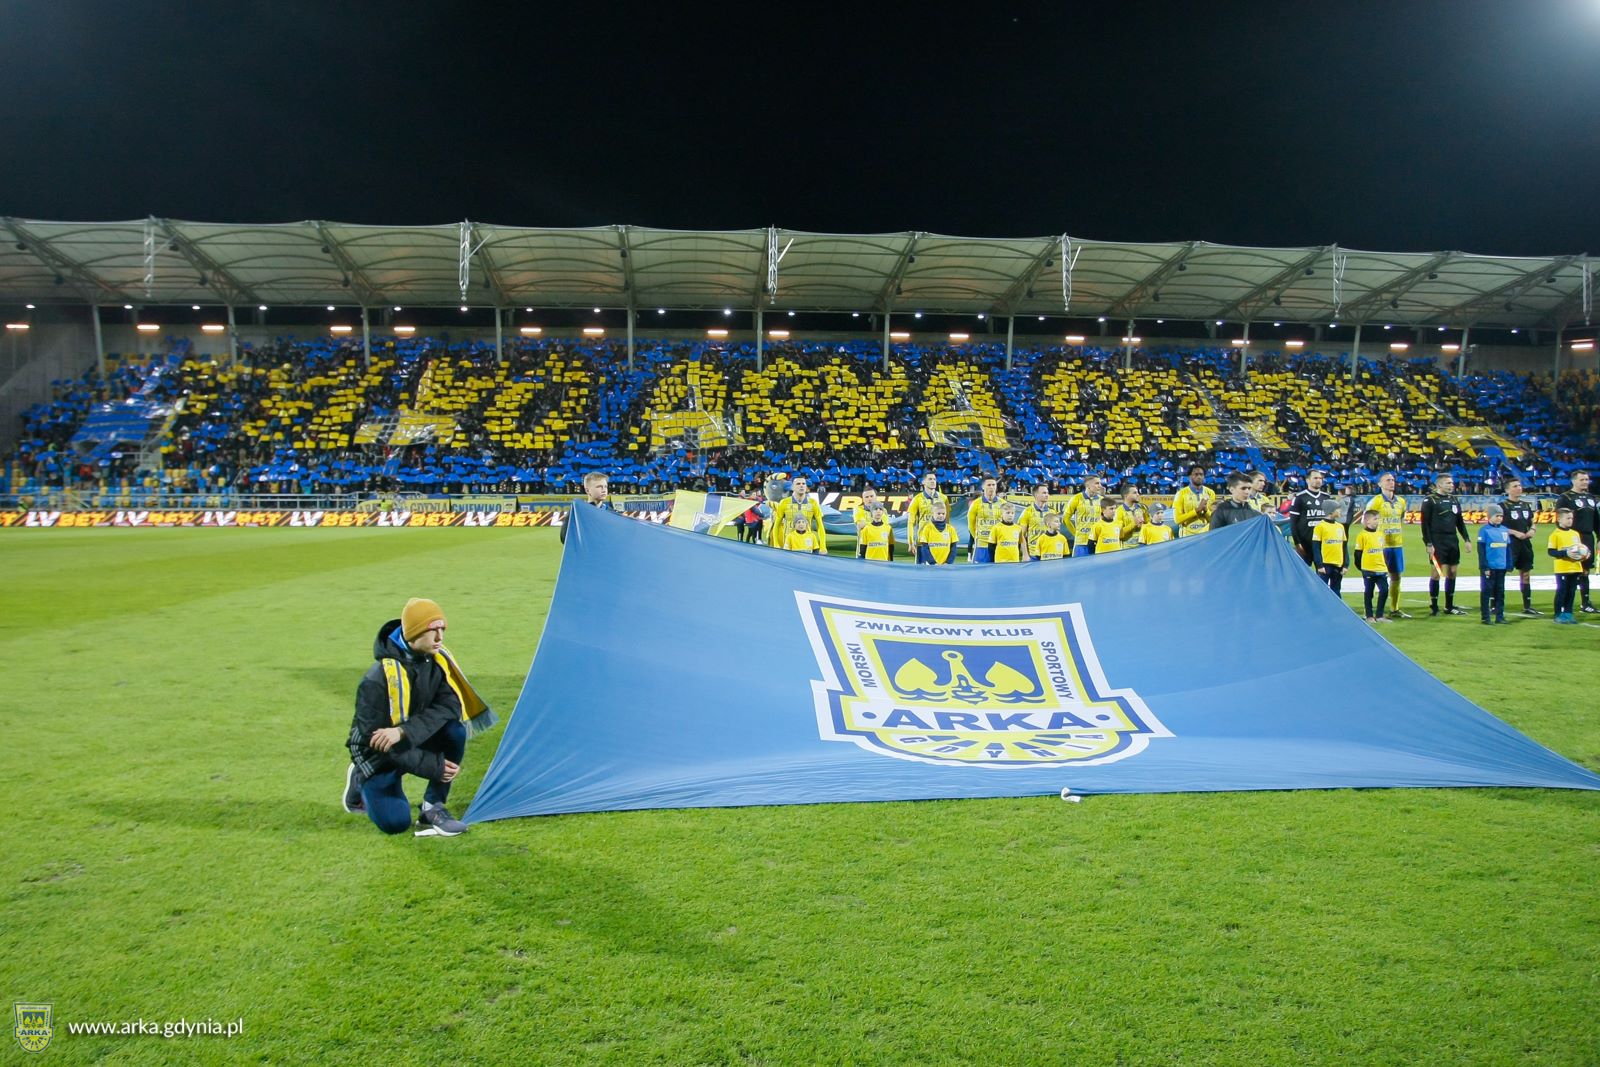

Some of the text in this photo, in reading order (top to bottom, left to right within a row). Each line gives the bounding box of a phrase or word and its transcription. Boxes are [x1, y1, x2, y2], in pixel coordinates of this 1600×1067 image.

[838, 496, 908, 511] BT
[25, 511, 60, 527] LV
[57, 512, 106, 527] BET
[290, 511, 324, 527] LV
[321, 512, 371, 527] BET
[377, 511, 411, 527] LV
[407, 512, 456, 527] BET
[463, 511, 498, 527] LV
[493, 512, 542, 527] BET
[854, 619, 1034, 638] ZWIĄZKOWY KLUB
[845, 642, 878, 688] MORSKI
[1041, 640, 1074, 700] SPORTOWY
[881, 708, 1097, 731] ARKA
